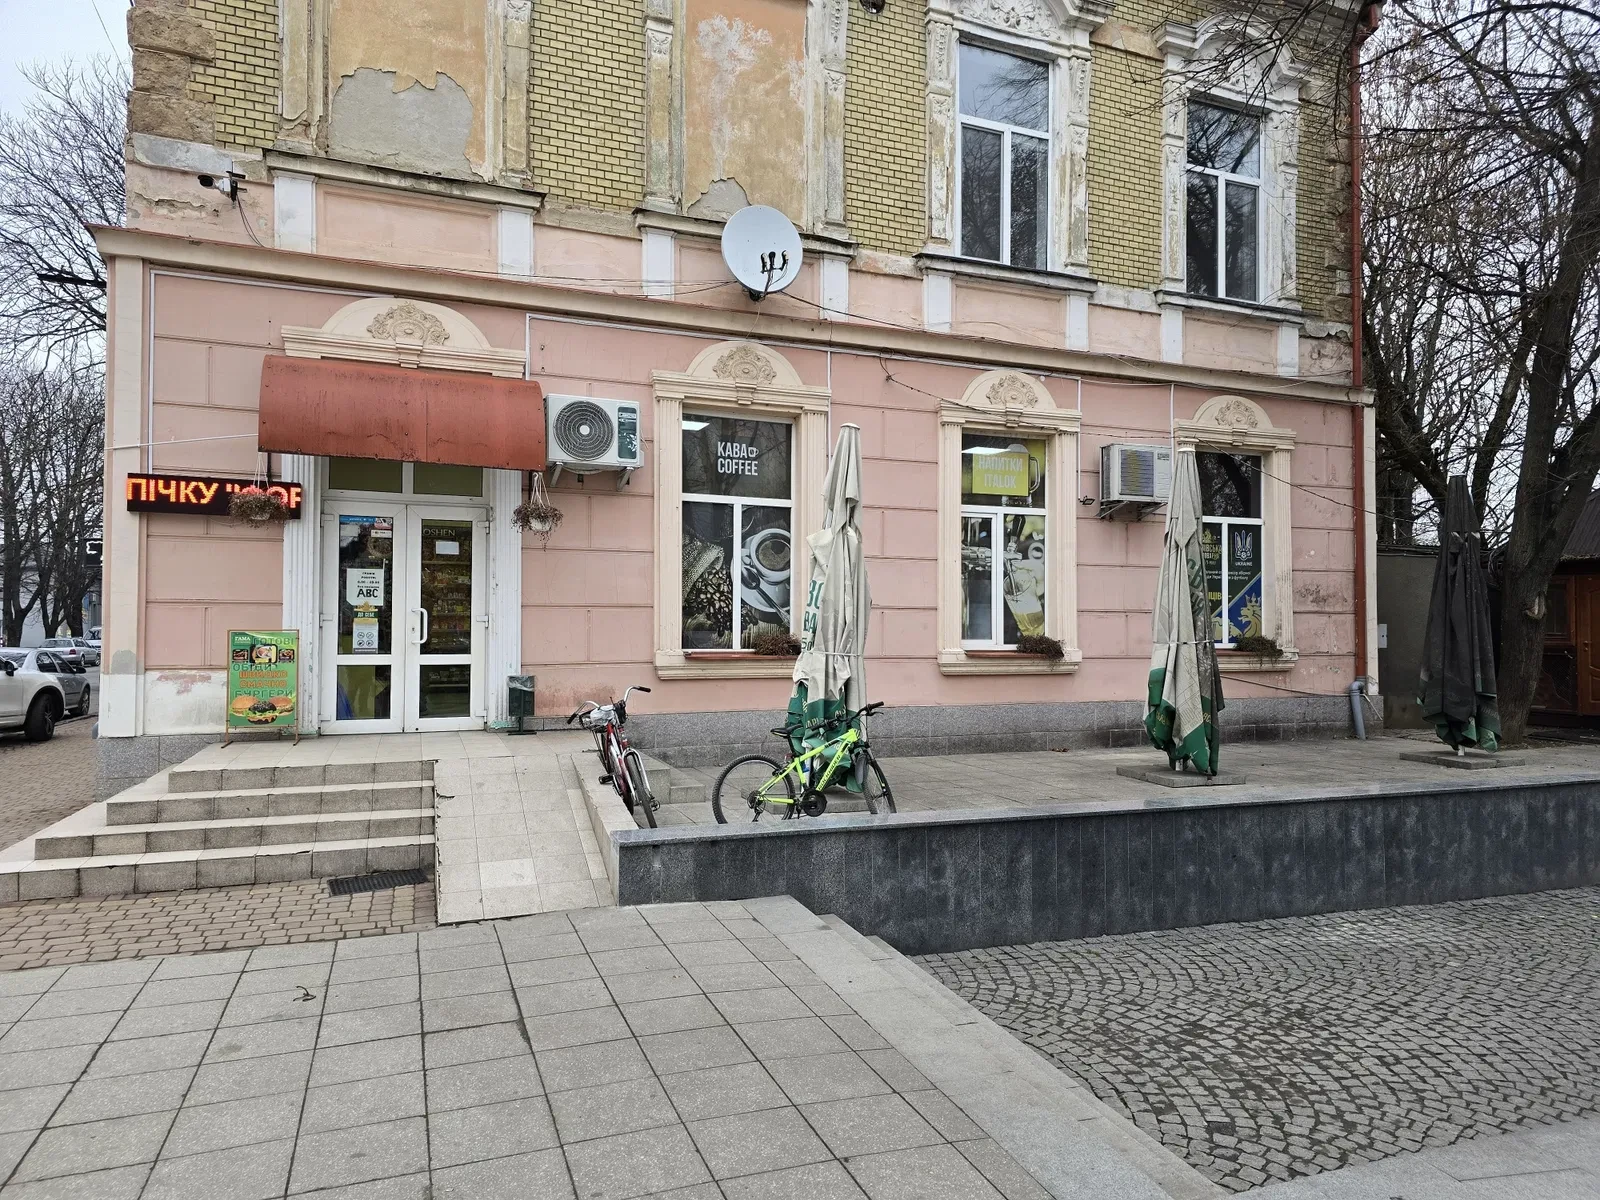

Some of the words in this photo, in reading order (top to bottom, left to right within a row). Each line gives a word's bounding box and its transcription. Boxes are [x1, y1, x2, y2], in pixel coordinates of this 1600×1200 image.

[717, 458, 759, 476] COFFEE
[978, 455, 1023, 472] НАПИТКИ
[984, 473, 1017, 489] ITALOK
[126, 478, 219, 505] ПІЧКУ
[422, 528, 456, 537] OSHEN
[253, 637, 294, 646] ГОТОВІ
[239, 670, 288, 679] ШВИДКО
[239, 679, 288, 689] СМАЧНО
[234, 689, 293, 698] БУРГЕРИ
